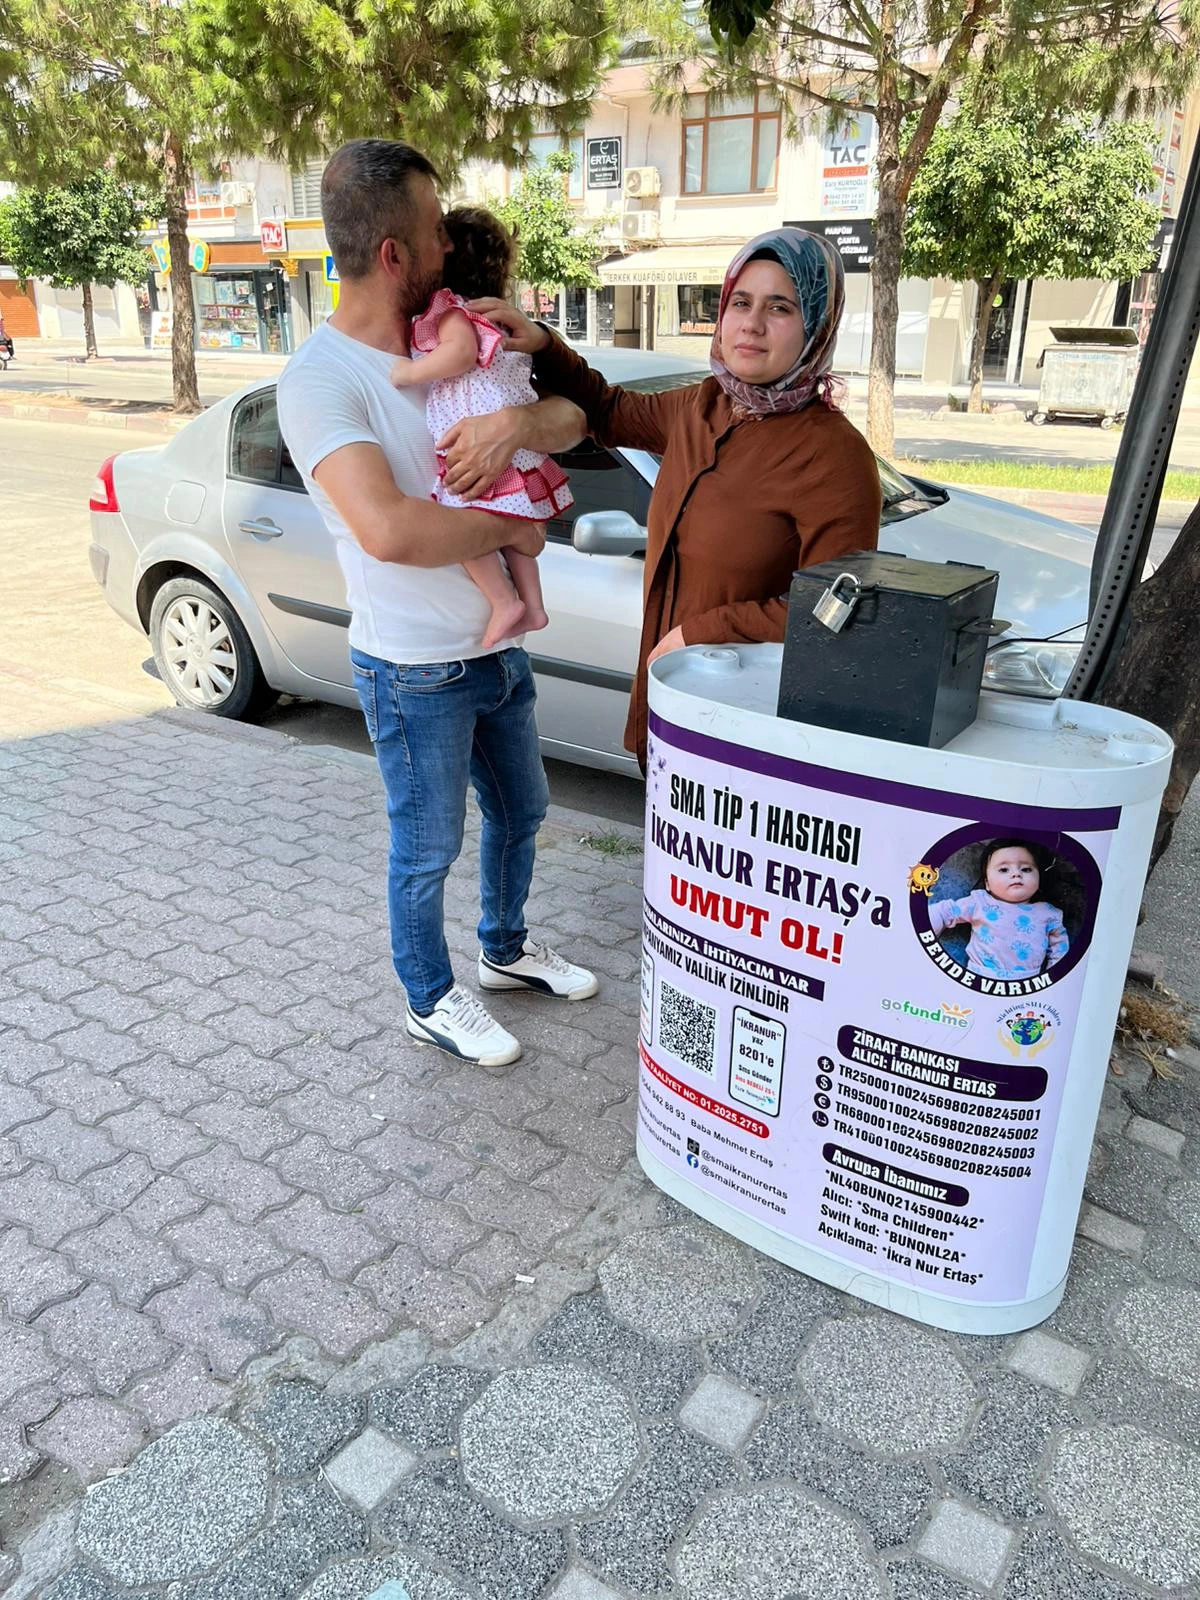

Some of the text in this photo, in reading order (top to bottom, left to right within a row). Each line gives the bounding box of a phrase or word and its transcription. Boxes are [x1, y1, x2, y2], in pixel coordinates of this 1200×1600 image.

[591, 154, 617, 167] ERTAŞ
[830, 145, 866, 165] TAÇ
[670, 773, 861, 866] SMA TİP 1 HASTASI
[651, 803, 891, 928] İKRANUR ERTAŞ'a
[670, 873, 844, 964] UMUT OL!
[685, 955, 727, 990] VALİLİK
[729, 972, 790, 1014] İZİNLİDİR
[703, 940, 775, 981] İHTİYACIM
[779, 971, 809, 993] VAR
[919, 930, 1052, 996] BENDE VARIM
[881, 997, 970, 1028] gofundme
[739, 1043, 774, 1068] 8201'e
[752, 1035, 764, 1046] yaz
[852, 1029, 960, 1073] ZİRAAT BANKASI
[851, 1046, 997, 1098] ALICI: İKRANUR ERTAŞ
[675, 1109, 686, 1121] 93
[690, 1118, 712, 1136] Baba
[713, 1131, 748, 1155] Mehmet
[749, 1151, 774, 1168] Ertaş
[700, 1097, 763, 1135] 01.2025.2751
[700, 1164, 787, 1215] @smaikranurertas
[701, 1149, 788, 1199] @smaikranurertas
[822, 1186, 852, 1208] Alıcı:
[832, 1149, 948, 1201] Avrupa İbanımız
[820, 1203, 851, 1226] Swift
[854, 1217, 880, 1237] kod:
[818, 1221, 878, 1255] Açıklama:
[915, 1258, 940, 1276] Nur
